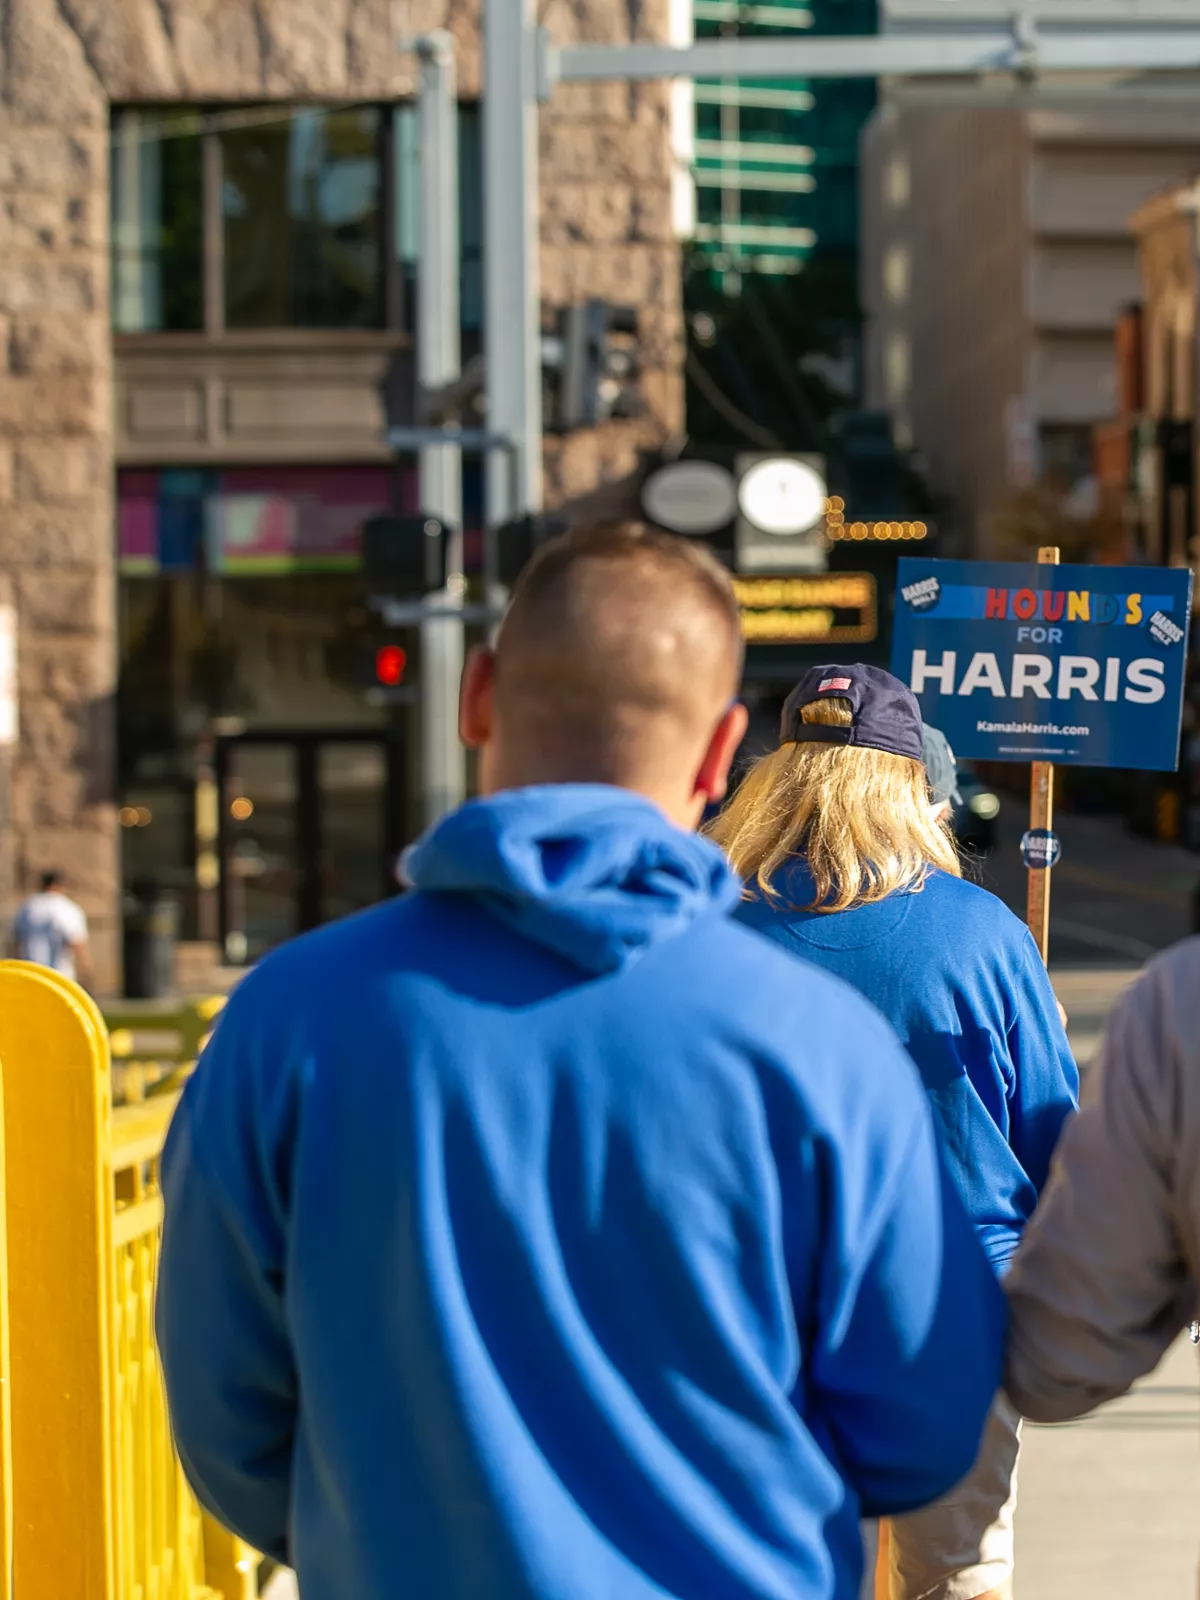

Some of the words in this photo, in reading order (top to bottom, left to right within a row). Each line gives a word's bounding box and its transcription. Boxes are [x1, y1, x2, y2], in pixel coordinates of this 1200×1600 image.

[901, 577, 939, 602] HARRIS
[984, 588, 1143, 625] HOUNDS
[1017, 626, 1063, 644] FOR
[1150, 611, 1184, 642] HARRIS
[910, 649, 1166, 704] HARRIS
[976, 721, 1090, 736] KamalaHarris.com
